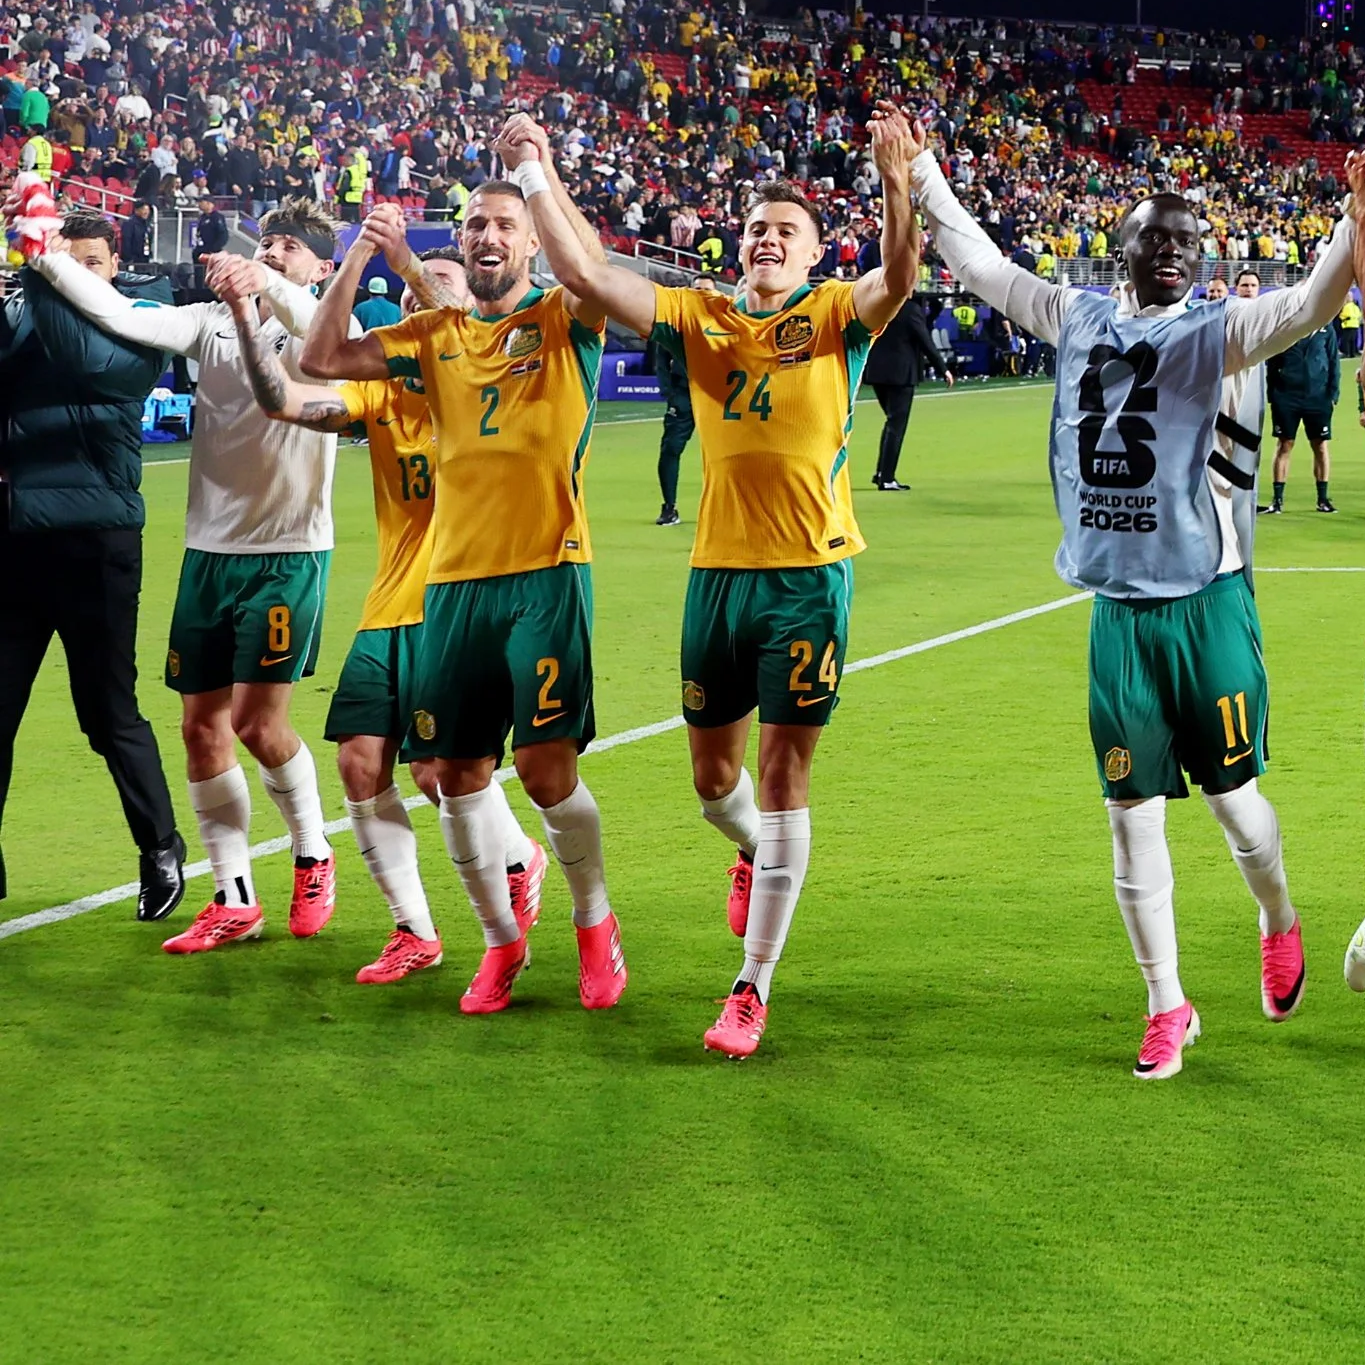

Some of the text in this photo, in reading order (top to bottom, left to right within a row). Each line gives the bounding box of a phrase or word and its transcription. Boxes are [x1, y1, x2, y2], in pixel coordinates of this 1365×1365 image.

[479, 385, 499, 436] 2
[723, 370, 772, 421] 24
[397, 454, 431, 501] 13
[1093, 458, 1131, 475] FIFA
[1080, 491, 1157, 509] WORLD CUP
[1080, 507, 1158, 532] 2026
[268, 605, 291, 652] 8
[536, 657, 562, 710] 2
[789, 640, 837, 692] 24
[1216, 691, 1250, 750] 11
